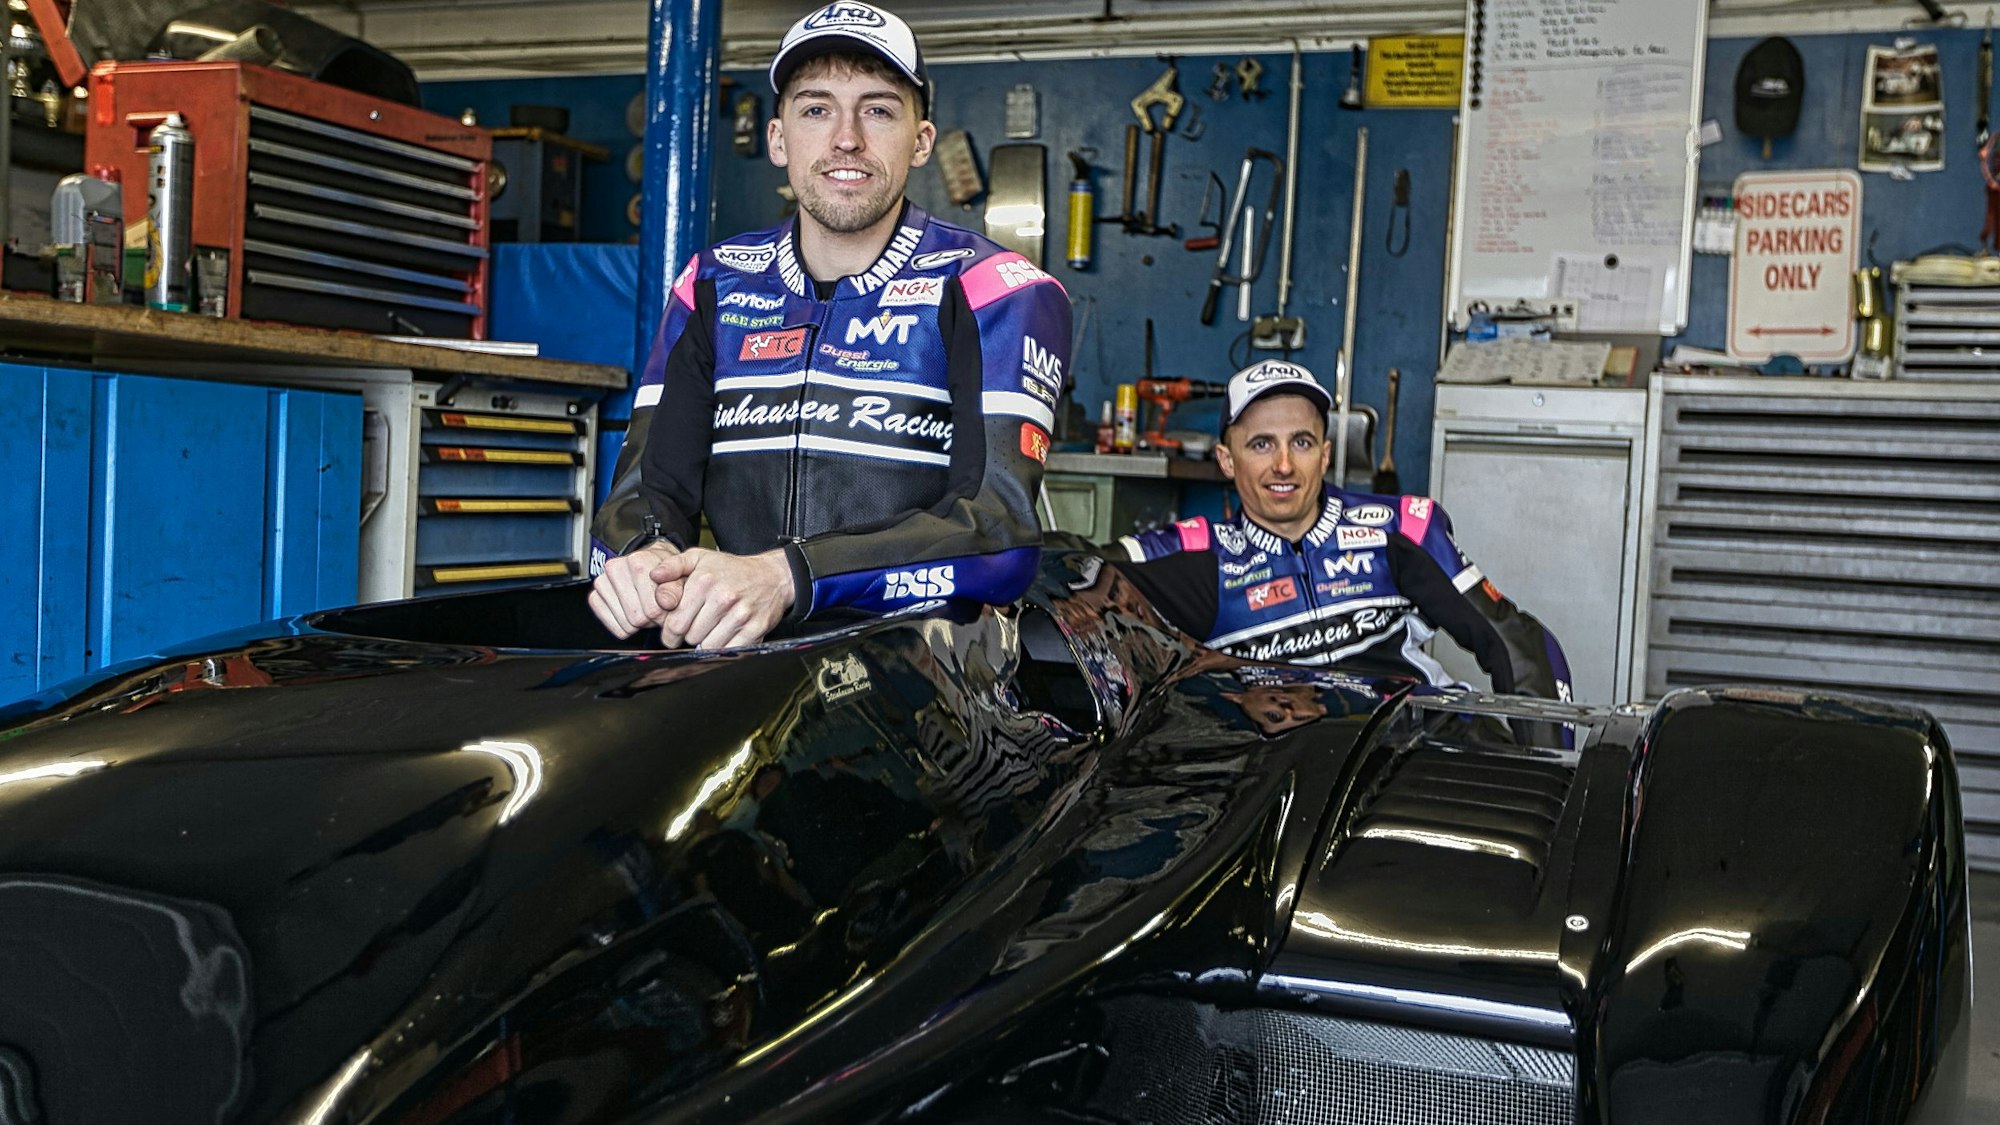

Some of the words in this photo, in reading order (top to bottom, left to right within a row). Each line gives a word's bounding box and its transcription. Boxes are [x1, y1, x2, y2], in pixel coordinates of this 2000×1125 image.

[820, 4, 877, 21] Arai
[1742, 191, 1850, 219] SIDECARS
[1747, 228, 1843, 255] PARKING
[718, 250, 773, 262] MOTO
[777, 231, 806, 297] YAMAHA
[850, 226, 924, 296] YAMAHA
[889, 281, 938, 296] NGK
[1764, 264, 1821, 291] ONLY
[844, 314, 920, 345] MVT
[1023, 334, 1063, 390] IWS
[713, 393, 841, 430] inhausen
[848, 396, 955, 451] Racing
[1305, 497, 1343, 548] YAMAHA
[1350, 506, 1386, 520] Arai
[1342, 528, 1379, 540] NGK
[1323, 551, 1375, 579] MVT
